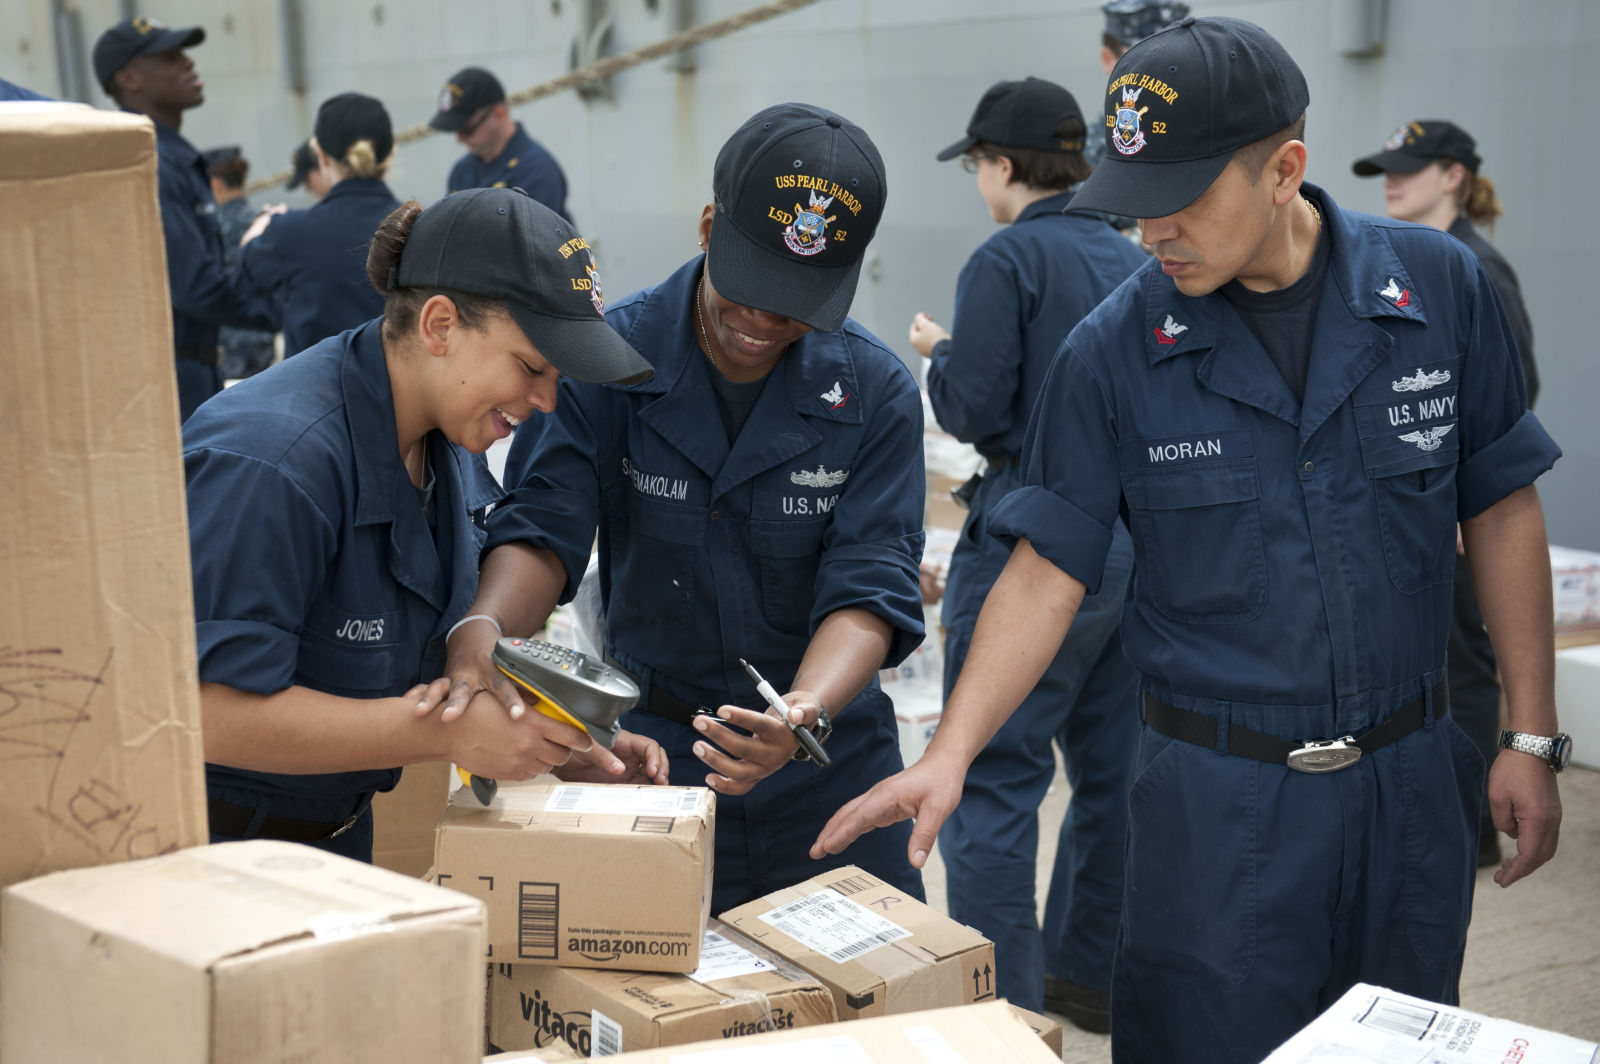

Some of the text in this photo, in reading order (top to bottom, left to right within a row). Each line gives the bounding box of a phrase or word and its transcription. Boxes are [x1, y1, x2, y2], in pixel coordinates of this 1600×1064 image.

[1138, 74, 1178, 105] HARBOR
[1152, 121, 1166, 134] 52
[775, 174, 863, 217] USS PEARL HARBOR
[767, 206, 793, 225] LSD
[834, 229, 848, 242] 52
[558, 237, 590, 259] USS PEA
[570, 278, 592, 291] LSD
[1388, 395, 1456, 427] U.S. NAVY
[1148, 438, 1222, 463] MORAN
[782, 496, 813, 515] U.S.
[336, 618, 385, 642] JONES
[568, 937, 688, 957] amazon.com
[519, 989, 592, 1058] vitaco
